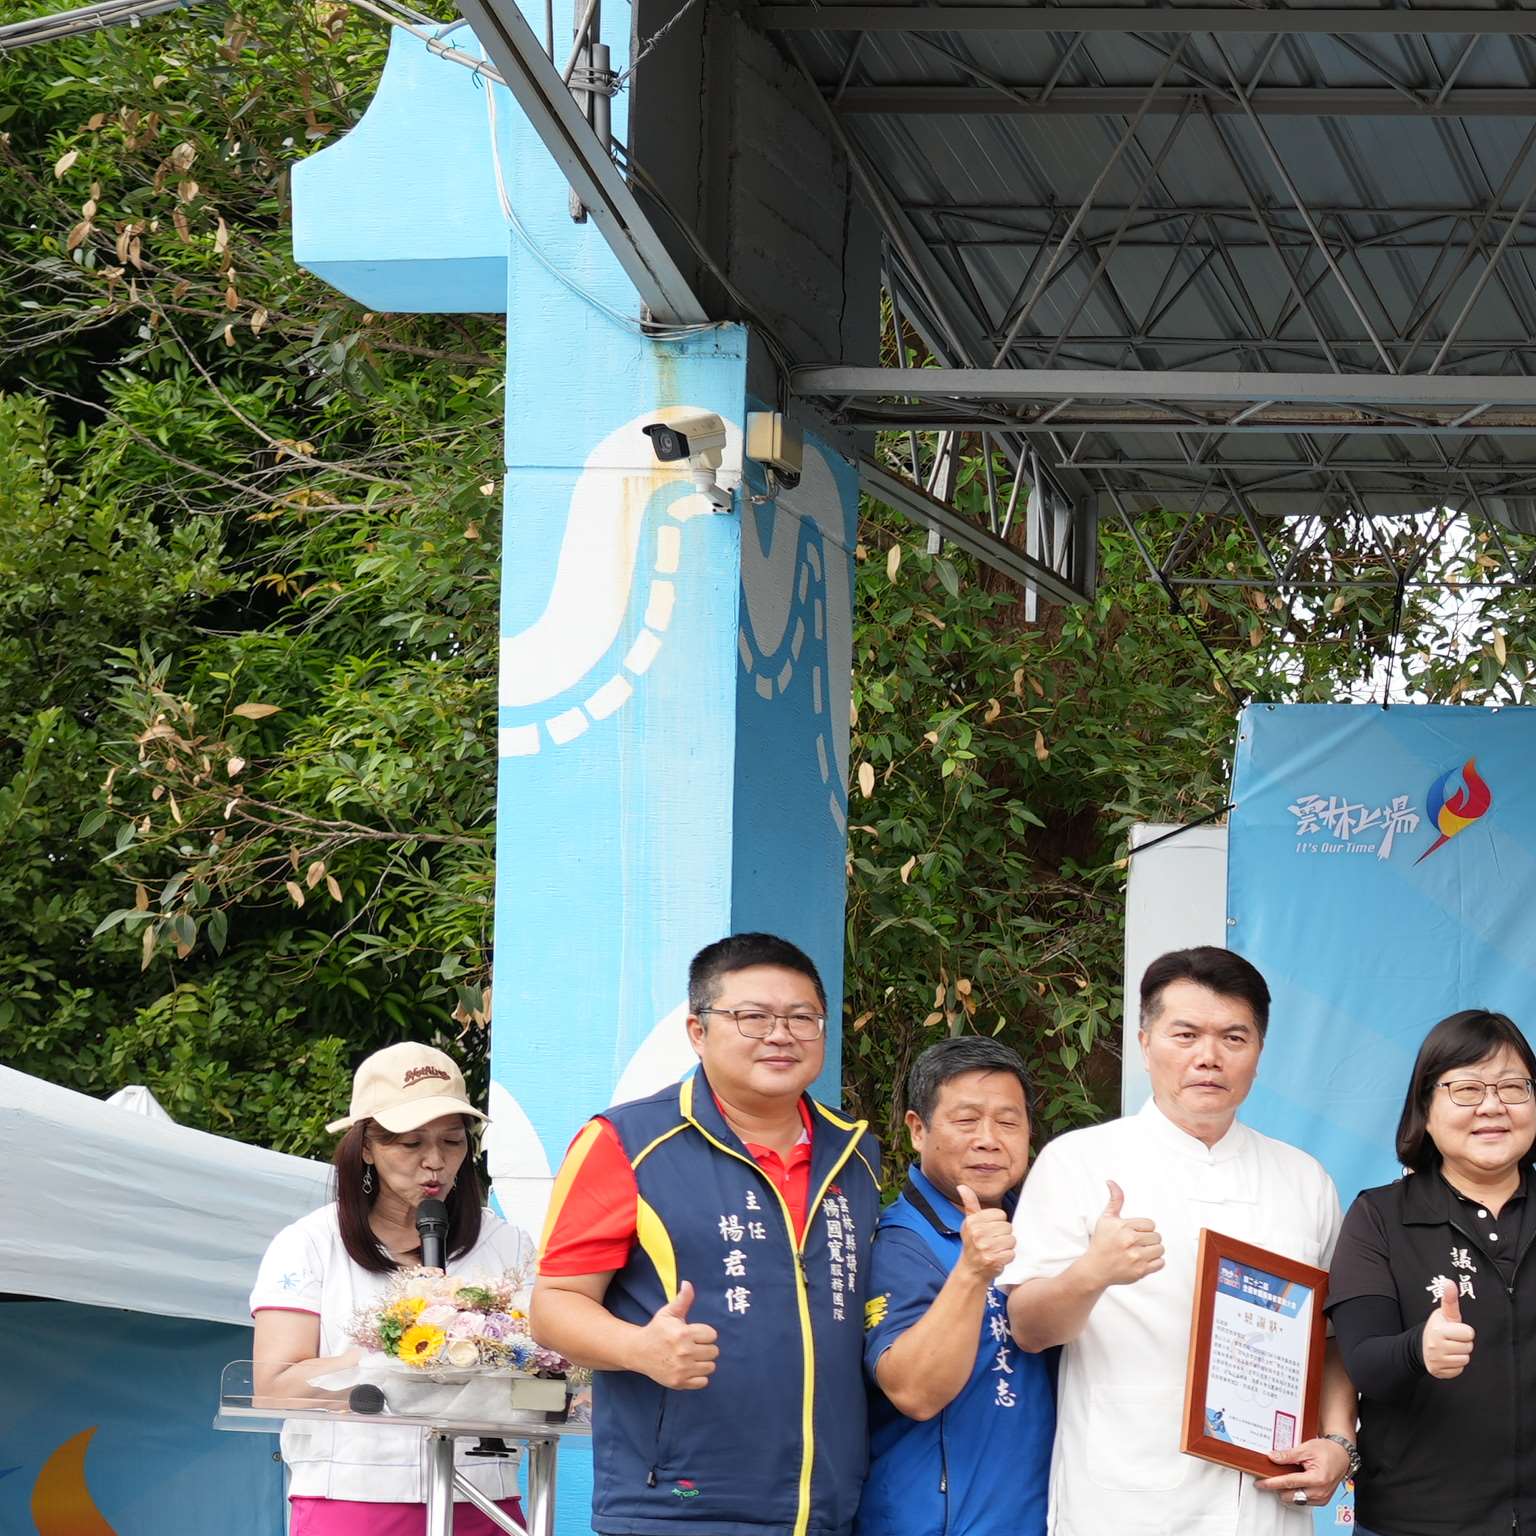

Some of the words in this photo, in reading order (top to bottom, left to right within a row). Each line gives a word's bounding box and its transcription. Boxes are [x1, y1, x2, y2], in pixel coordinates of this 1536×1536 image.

[1288, 794, 1420, 862] 雲林上場
[1296, 842, 1318, 853] It's
[1321, 842, 1344, 853] Our
[1346, 842, 1376, 853] Time
[746, 1190, 767, 1240] 主任
[718, 1214, 751, 1314] 楊君偉
[1449, 1246, 1478, 1300] 議員
